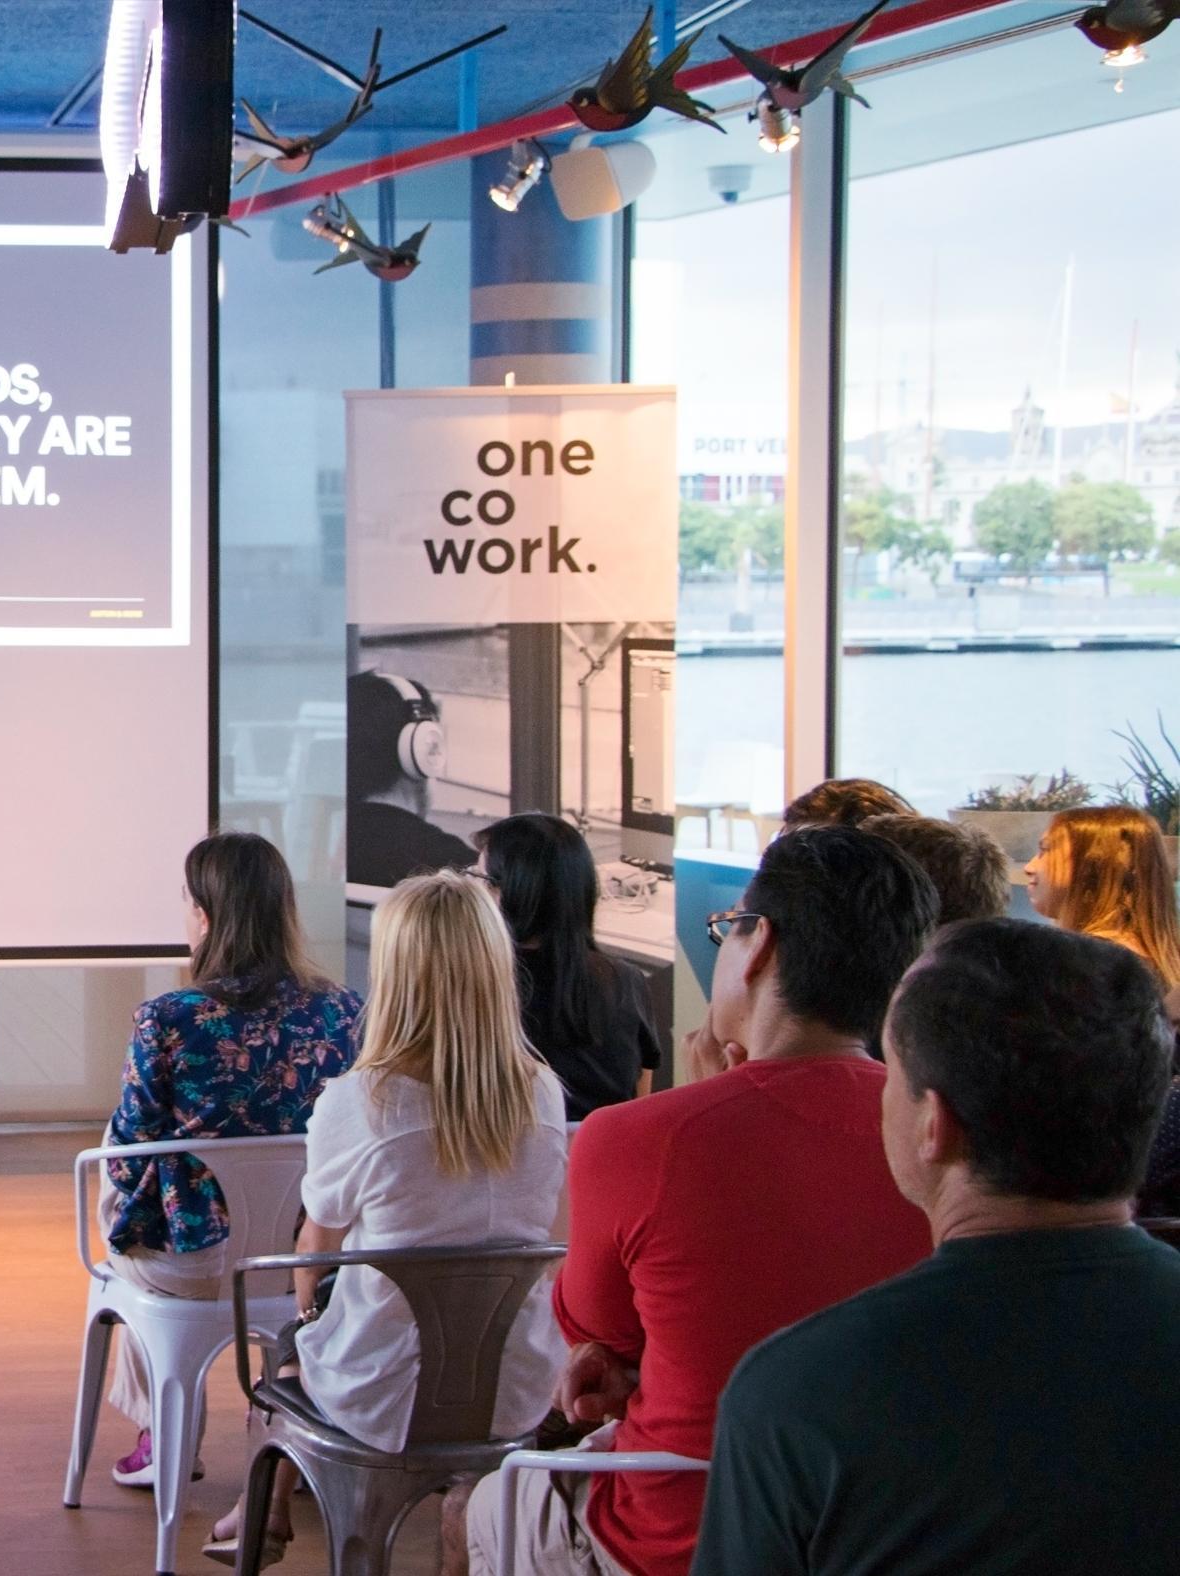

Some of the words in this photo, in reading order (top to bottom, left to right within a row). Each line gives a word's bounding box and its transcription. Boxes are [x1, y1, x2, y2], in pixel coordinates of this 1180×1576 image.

[38, 415, 132, 456] ARE
[694, 438, 746, 454] PORT
[477, 440, 594, 477] one
[441, 489, 515, 527] co
[423, 526, 596, 574] work.
